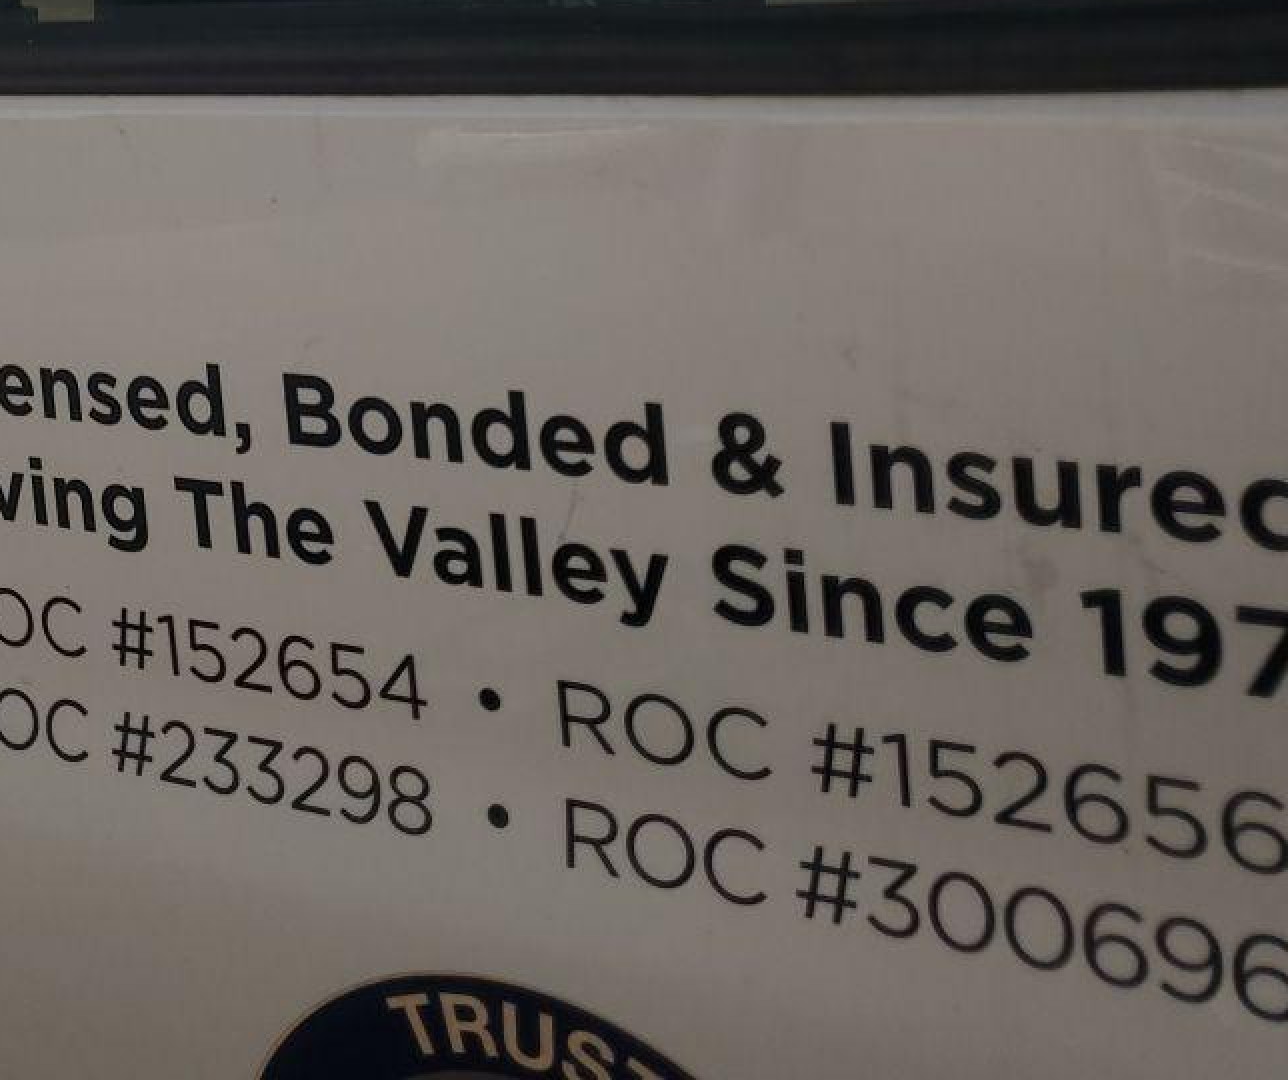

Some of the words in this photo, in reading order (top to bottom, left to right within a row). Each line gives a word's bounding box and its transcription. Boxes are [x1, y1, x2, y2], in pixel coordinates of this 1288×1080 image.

[282, 372, 668, 486] Bonded
[712, 412, 784, 498] &
[174, 476, 334, 566] The
[362, 500, 668, 628] Valley
[712, 544, 1032, 662] Since
[112, 608, 428, 720] #152654
[556, 680, 772, 780] ROC
[812, 722, 1288, 874] #152656
[112, 712, 432, 836] #233298
[566, 798, 768, 906] ROC
[796, 846, 1288, 1022] #300696
